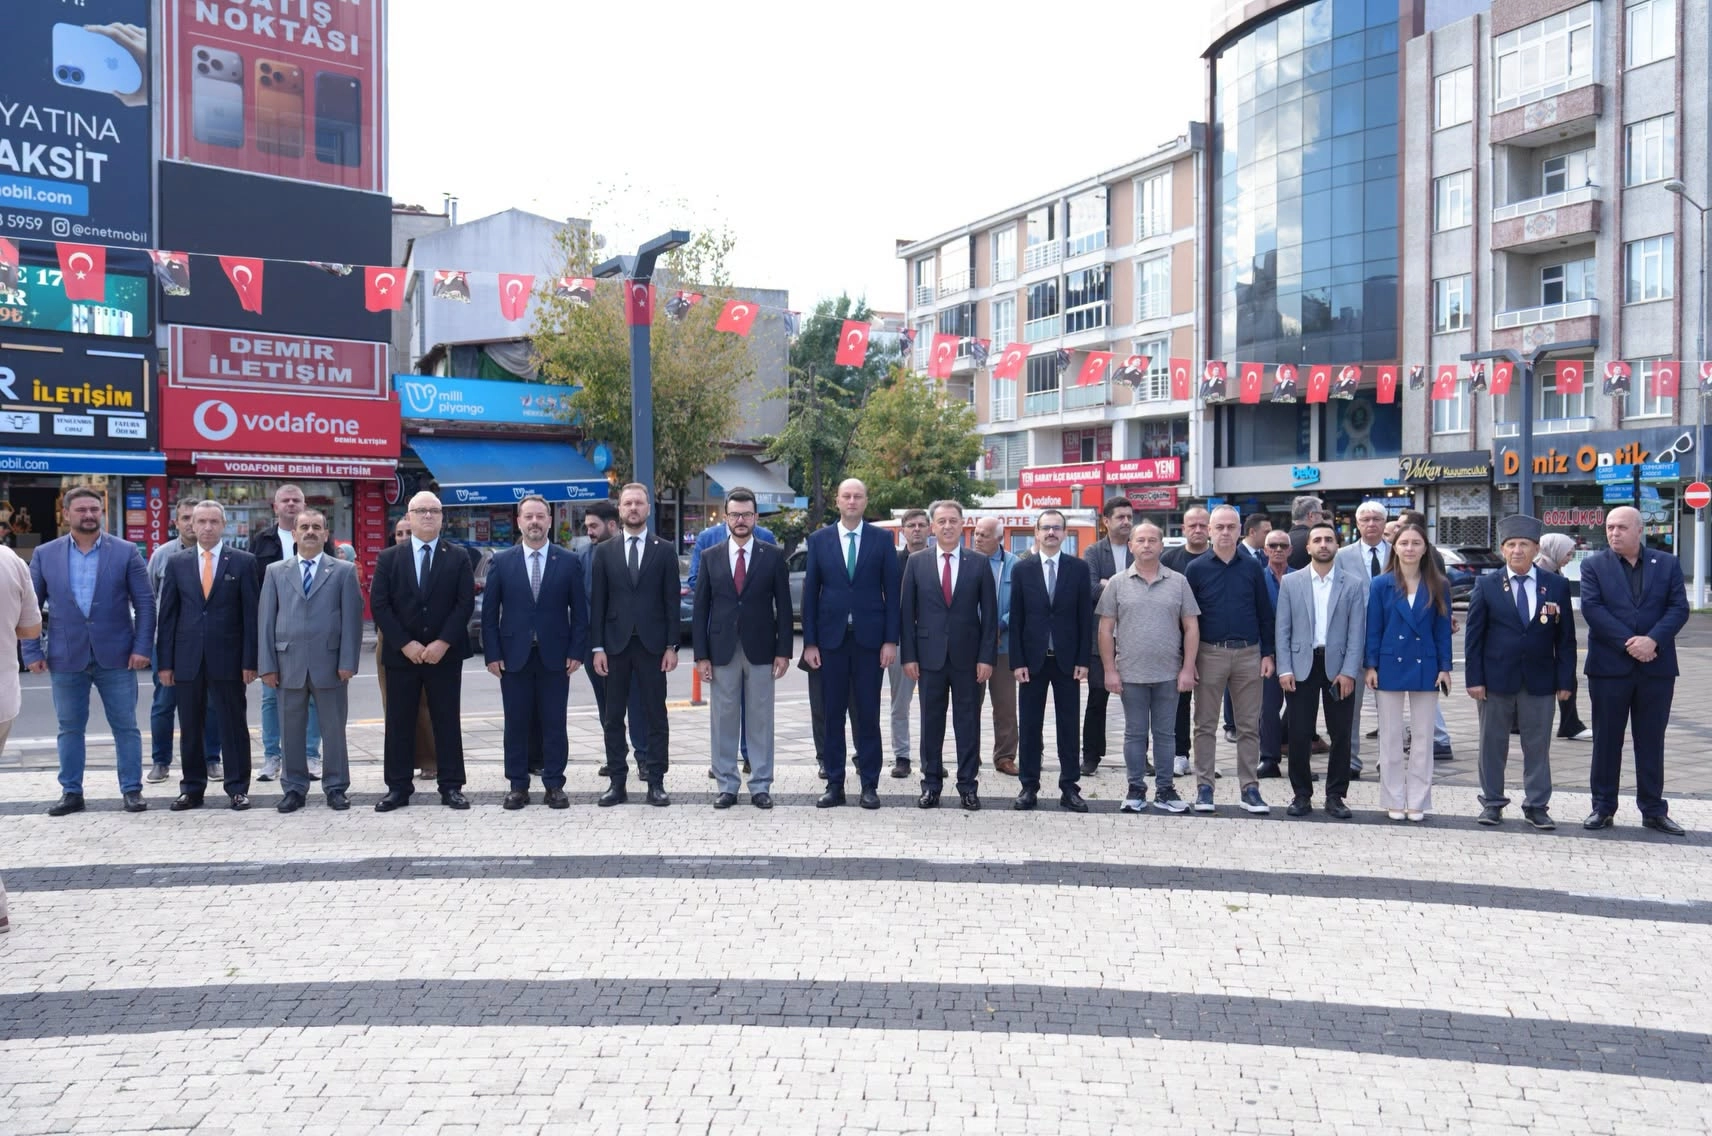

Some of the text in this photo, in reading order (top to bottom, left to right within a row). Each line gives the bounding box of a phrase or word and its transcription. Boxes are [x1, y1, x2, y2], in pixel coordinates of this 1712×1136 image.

[230, 0, 332, 28] ATIŞ
[196, 2, 359, 56] NOKTASI
[0, 138, 108, 183] AKSİT
[0, 184, 73, 205] obil.com
[7, 214, 43, 230] 5959
[72, 223, 147, 243] @cnetmobil
[36, 268, 63, 287] 17
[230, 337, 335, 361] DEMİR
[209, 354, 352, 384] İLETİŞİM
[32, 378, 133, 408] İLETİŞİM
[438, 391, 463, 401] milli
[438, 402, 485, 417] piyango
[242, 411, 360, 436] vodafone
[334, 436, 388, 446] DEMİR İLETİŞİM
[0, 457, 49, 471] obil.com
[1119, 463, 1139, 471] SARAY
[1503, 441, 1650, 476] Dniz Optik
[224, 462, 286, 474] VODAFONE
[288, 463, 323, 476] DEMİR
[1034, 473, 1053, 482] SARAY
[1053, 471, 1066, 483] İLÇE
[1066, 466, 1100, 482] BAŞKANLIĞI
[1120, 468, 1154, 482] BAŞKANLIĞI
[1291, 465, 1320, 480] beko
[1400, 456, 1442, 482] Volkan
[1032, 495, 1062, 506] vodafone
[997, 514, 1030, 526] ÖFTE
[1543, 508, 1605, 530] GÖZLÜKÇÜ
